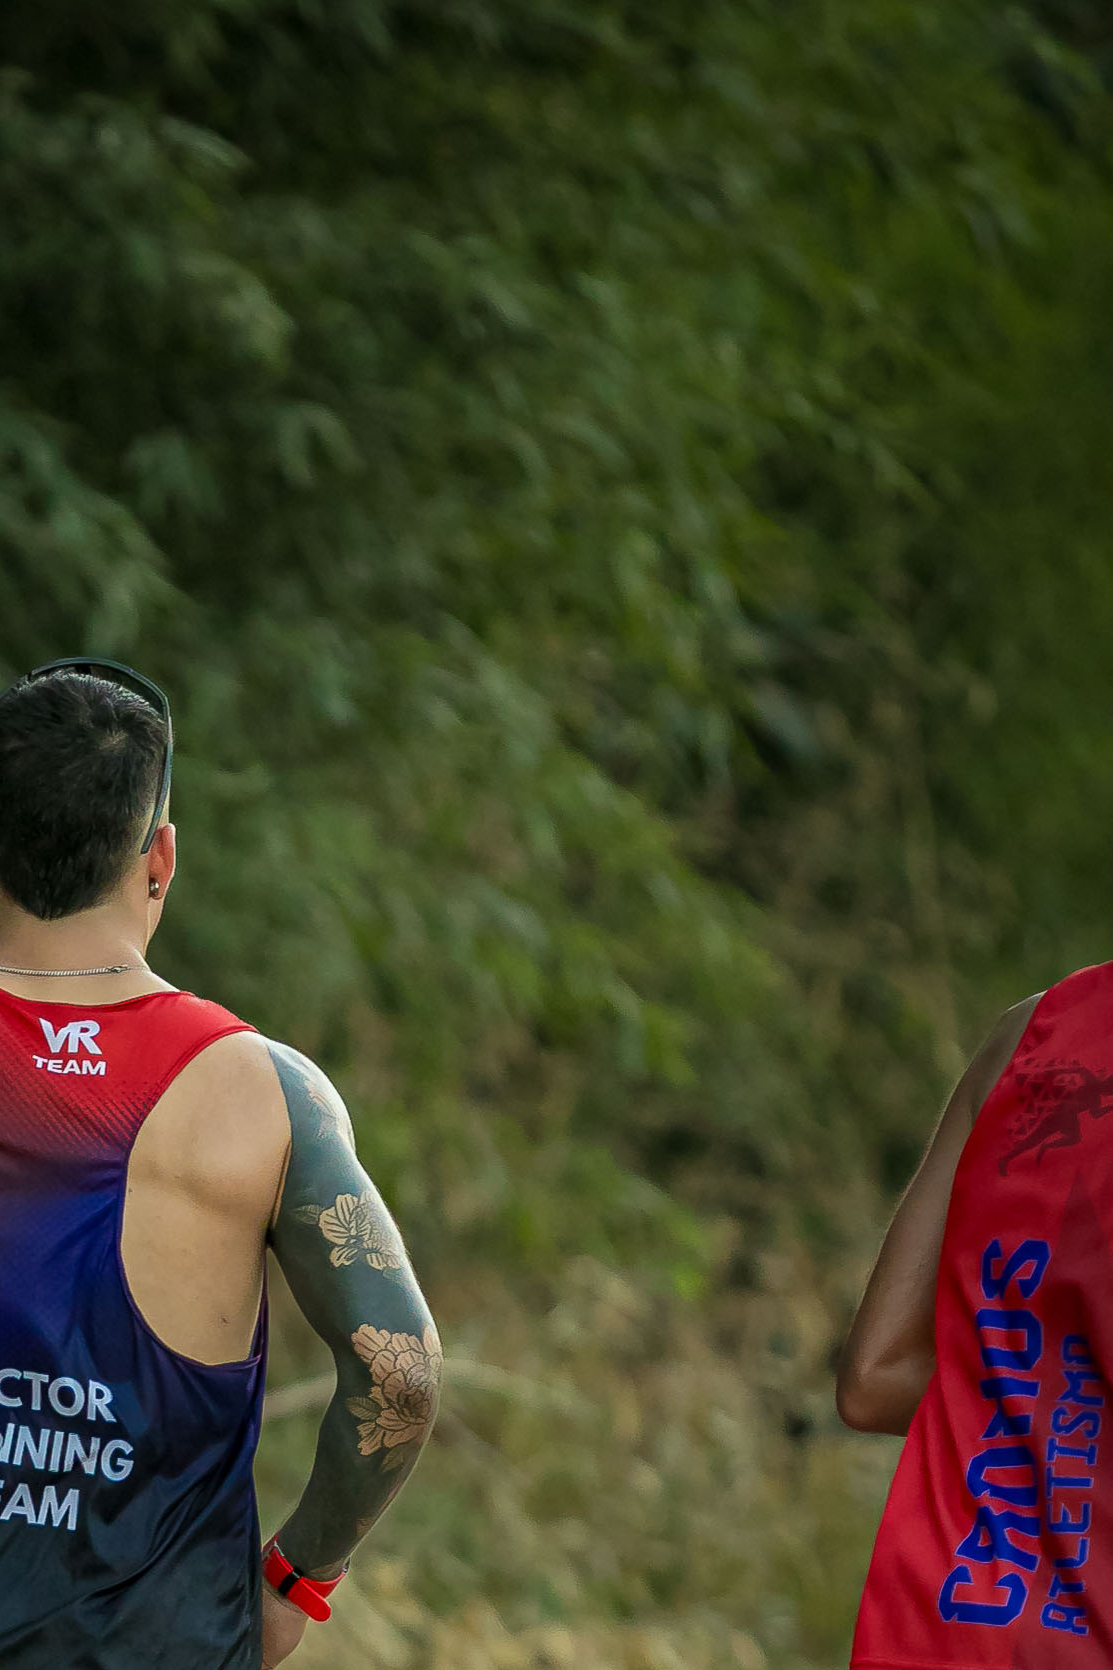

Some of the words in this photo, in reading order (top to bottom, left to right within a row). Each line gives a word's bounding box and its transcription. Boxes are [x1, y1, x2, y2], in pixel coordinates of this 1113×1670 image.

[38, 1017, 103, 1055] VR
[32, 1055, 107, 1076] TEAM
[1040, 1333, 1105, 1636] ATLETISMO
